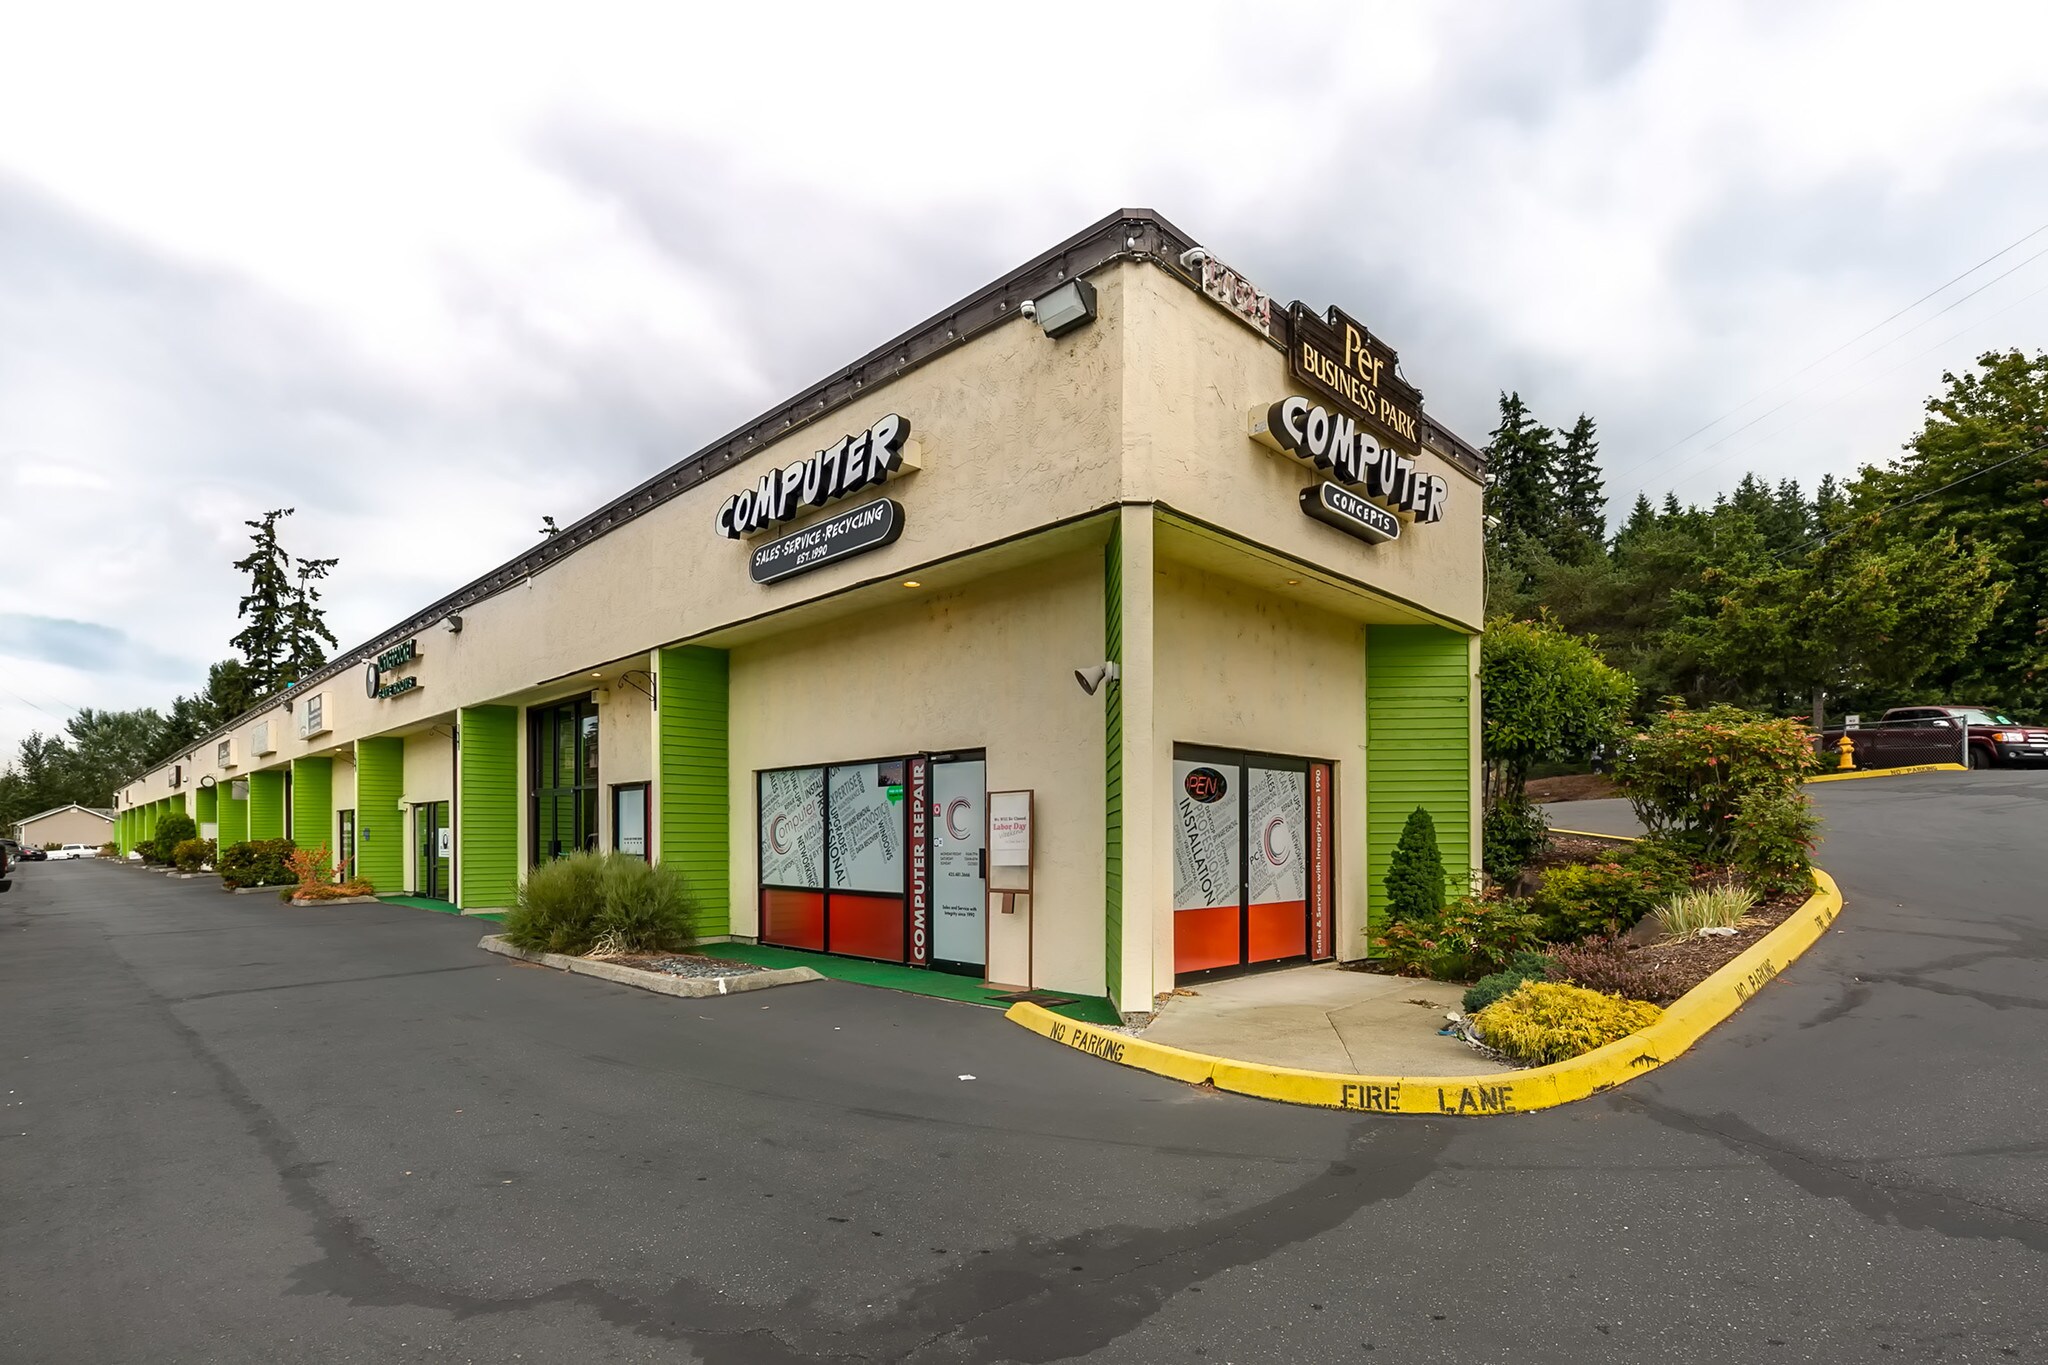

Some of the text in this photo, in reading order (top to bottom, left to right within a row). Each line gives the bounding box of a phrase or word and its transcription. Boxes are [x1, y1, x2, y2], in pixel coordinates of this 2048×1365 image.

[1345, 323, 1384, 387] Per
[1303, 342, 1417, 444] BUSINESS PARK
[715, 413, 906, 538] COMPUTER
[1282, 396, 1448, 521] COMPUTER
[1333, 493, 1391, 530] CONCEPTS
[755, 547, 781, 566] SALES
[1185, 774, 1217, 795] PEN
[1907, 766, 1937, 774] PARKING
[831, 806, 848, 856] UPGRADES
[878, 819, 893, 862] WINDOWS
[993, 822, 1026, 831] Labor Day
[1315, 820, 1323, 860] Integrity
[797, 835, 815, 890] NETWORKING
[913, 764, 925, 960] COMPUTER REPAIR
[1179, 797, 1216, 907] INSTALLATION
[1193, 803, 1225, 901] PROFESSIONAL
[1734, 982, 1749, 1002] NO
[1050, 1021, 1125, 1061] NO PARKING
[1341, 1084, 1516, 1113] FIRE LANE
